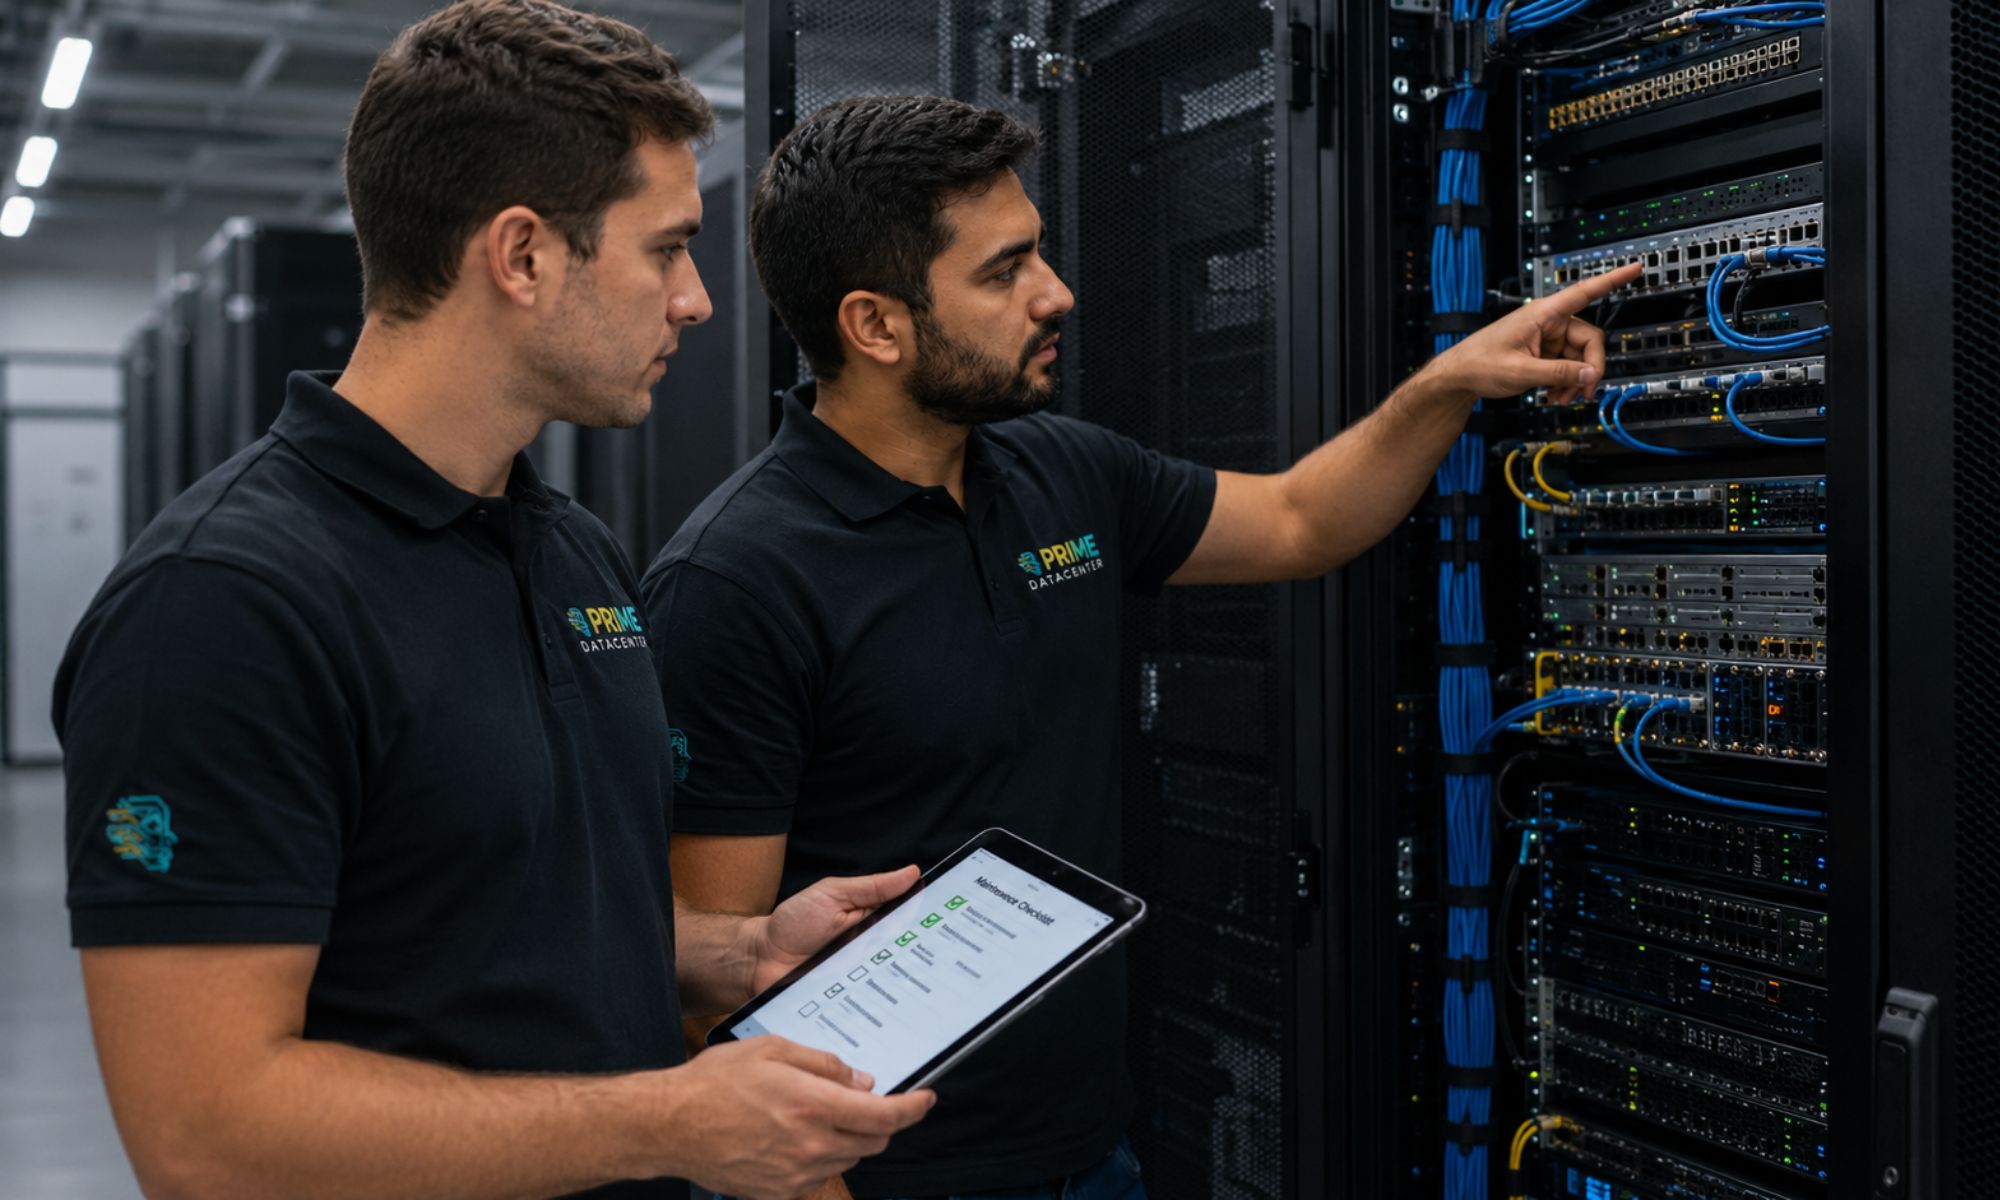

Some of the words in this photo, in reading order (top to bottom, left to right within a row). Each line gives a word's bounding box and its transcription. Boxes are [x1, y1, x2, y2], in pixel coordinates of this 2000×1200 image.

[1039, 533, 1100, 571] PRIME
[1028, 558, 1104, 591] DATACENTER
[585, 606, 643, 634] PRIME
